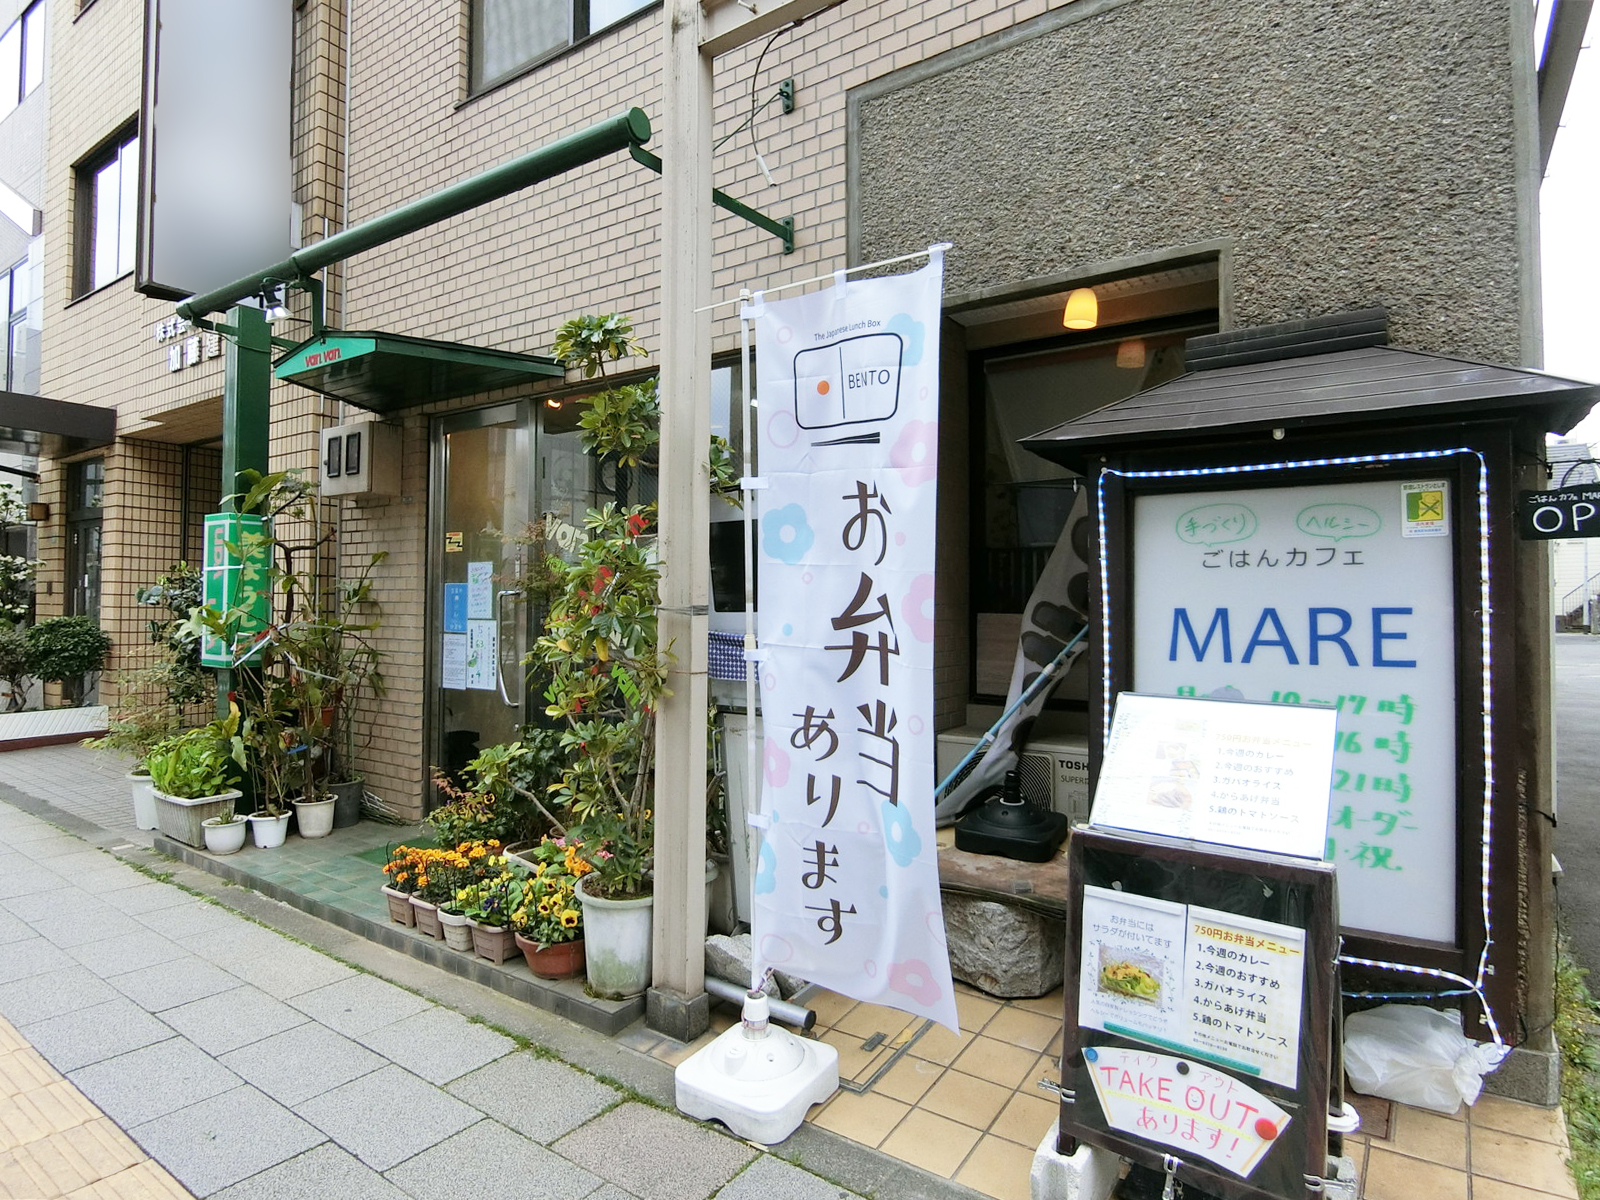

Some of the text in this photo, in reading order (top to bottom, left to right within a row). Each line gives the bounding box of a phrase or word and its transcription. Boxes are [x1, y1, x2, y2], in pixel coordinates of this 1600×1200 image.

[814, 319, 881, 341] The Japanese Lunch Box
[848, 369, 890, 389] BENTO
[1184, 513, 1370, 536] 手づくり ヘルシー
[1202, 547, 1364, 569] ごはんカフェ
[824, 480, 900, 807] お弁当
[1169, 607, 1417, 668] MARE
[1215, 732, 1312, 747] 750円お弁当メニュー
[1059, 759, 1089, 771] TOSH
[1218, 747, 1285, 760] 1.今週のカレー
[1215, 761, 1294, 776] 2.今週のおすすめ
[1211, 791, 1281, 806] 4.からあげ弁当
[790, 705, 857, 946] あります
[1209, 805, 1300, 824] 5.鶏のトマトソース
[1110, 914, 1154, 931] お弁当には
[1092, 923, 1172, 949] サラダが付いてます
[1194, 924, 1300, 955] 750円お弁当メニュー
[1197, 943, 1270, 966] 1.今週のカレー
[1195, 961, 1281, 990] 2.今週のおすすめ
[1193, 995, 1268, 1024] 4.からあげ弁当
[1192, 1012, 1288, 1047] 5.鶏のトマトソース
[1199, 1070, 1240, 1094] アウト
[1100, 1066, 1259, 1129] TAKE OUT
